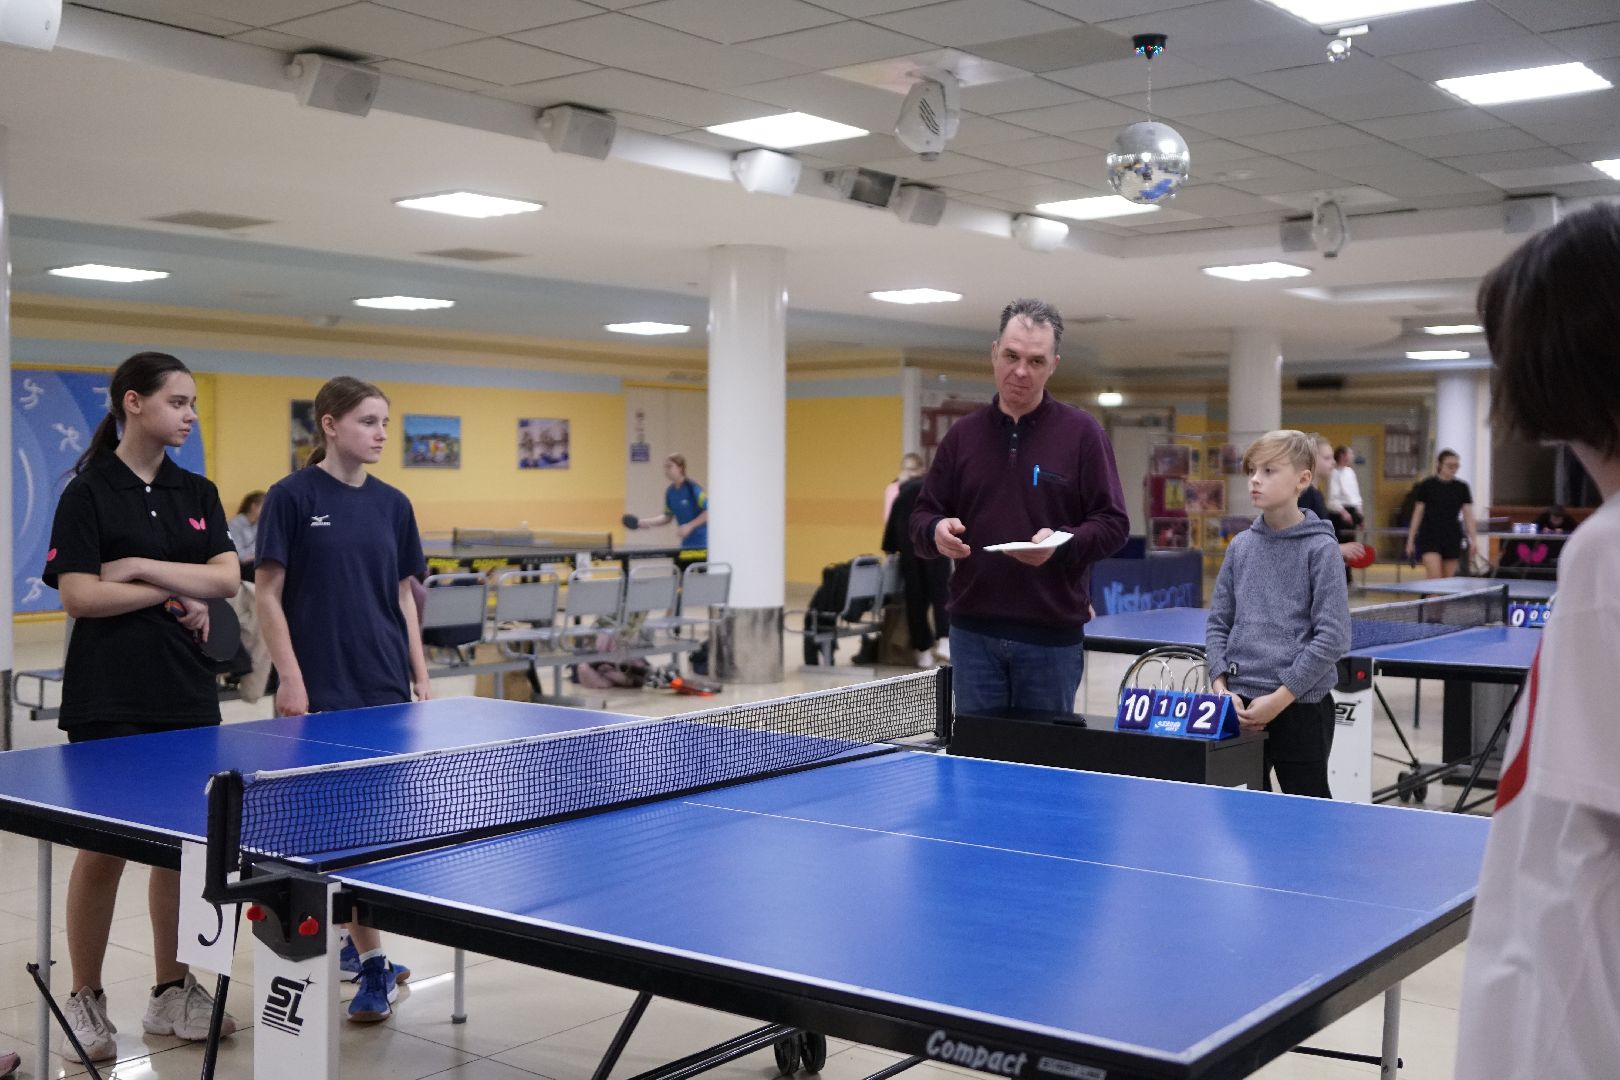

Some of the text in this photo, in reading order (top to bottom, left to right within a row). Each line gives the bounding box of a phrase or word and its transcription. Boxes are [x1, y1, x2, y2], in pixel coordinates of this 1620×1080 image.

[1512, 608, 1525, 627] 0
[1125, 694, 1150, 722] 10
[1160, 699, 1168, 715] 1
[1174, 701, 1187, 718] 0
[1193, 701, 1216, 729] 2
[926, 1029, 1028, 1077] Compact
